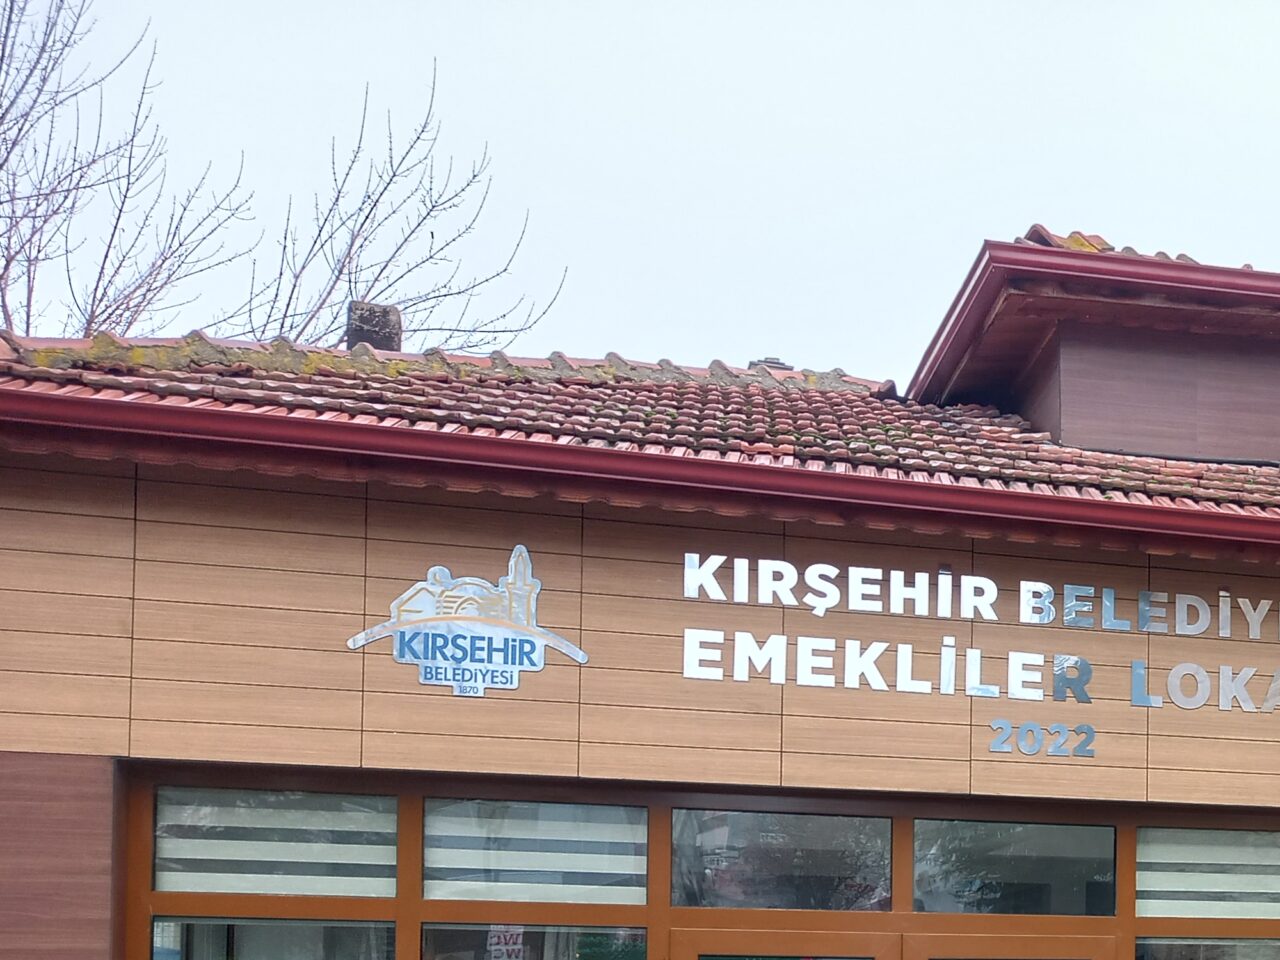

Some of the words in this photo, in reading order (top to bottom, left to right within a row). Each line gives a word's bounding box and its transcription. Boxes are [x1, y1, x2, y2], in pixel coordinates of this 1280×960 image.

[683, 552, 999, 621] KIRŞEHİR
[458, 685, 479, 695] 1870
[682, 628, 1093, 704] EMEKLİLER
[989, 719, 1096, 758] 2022
